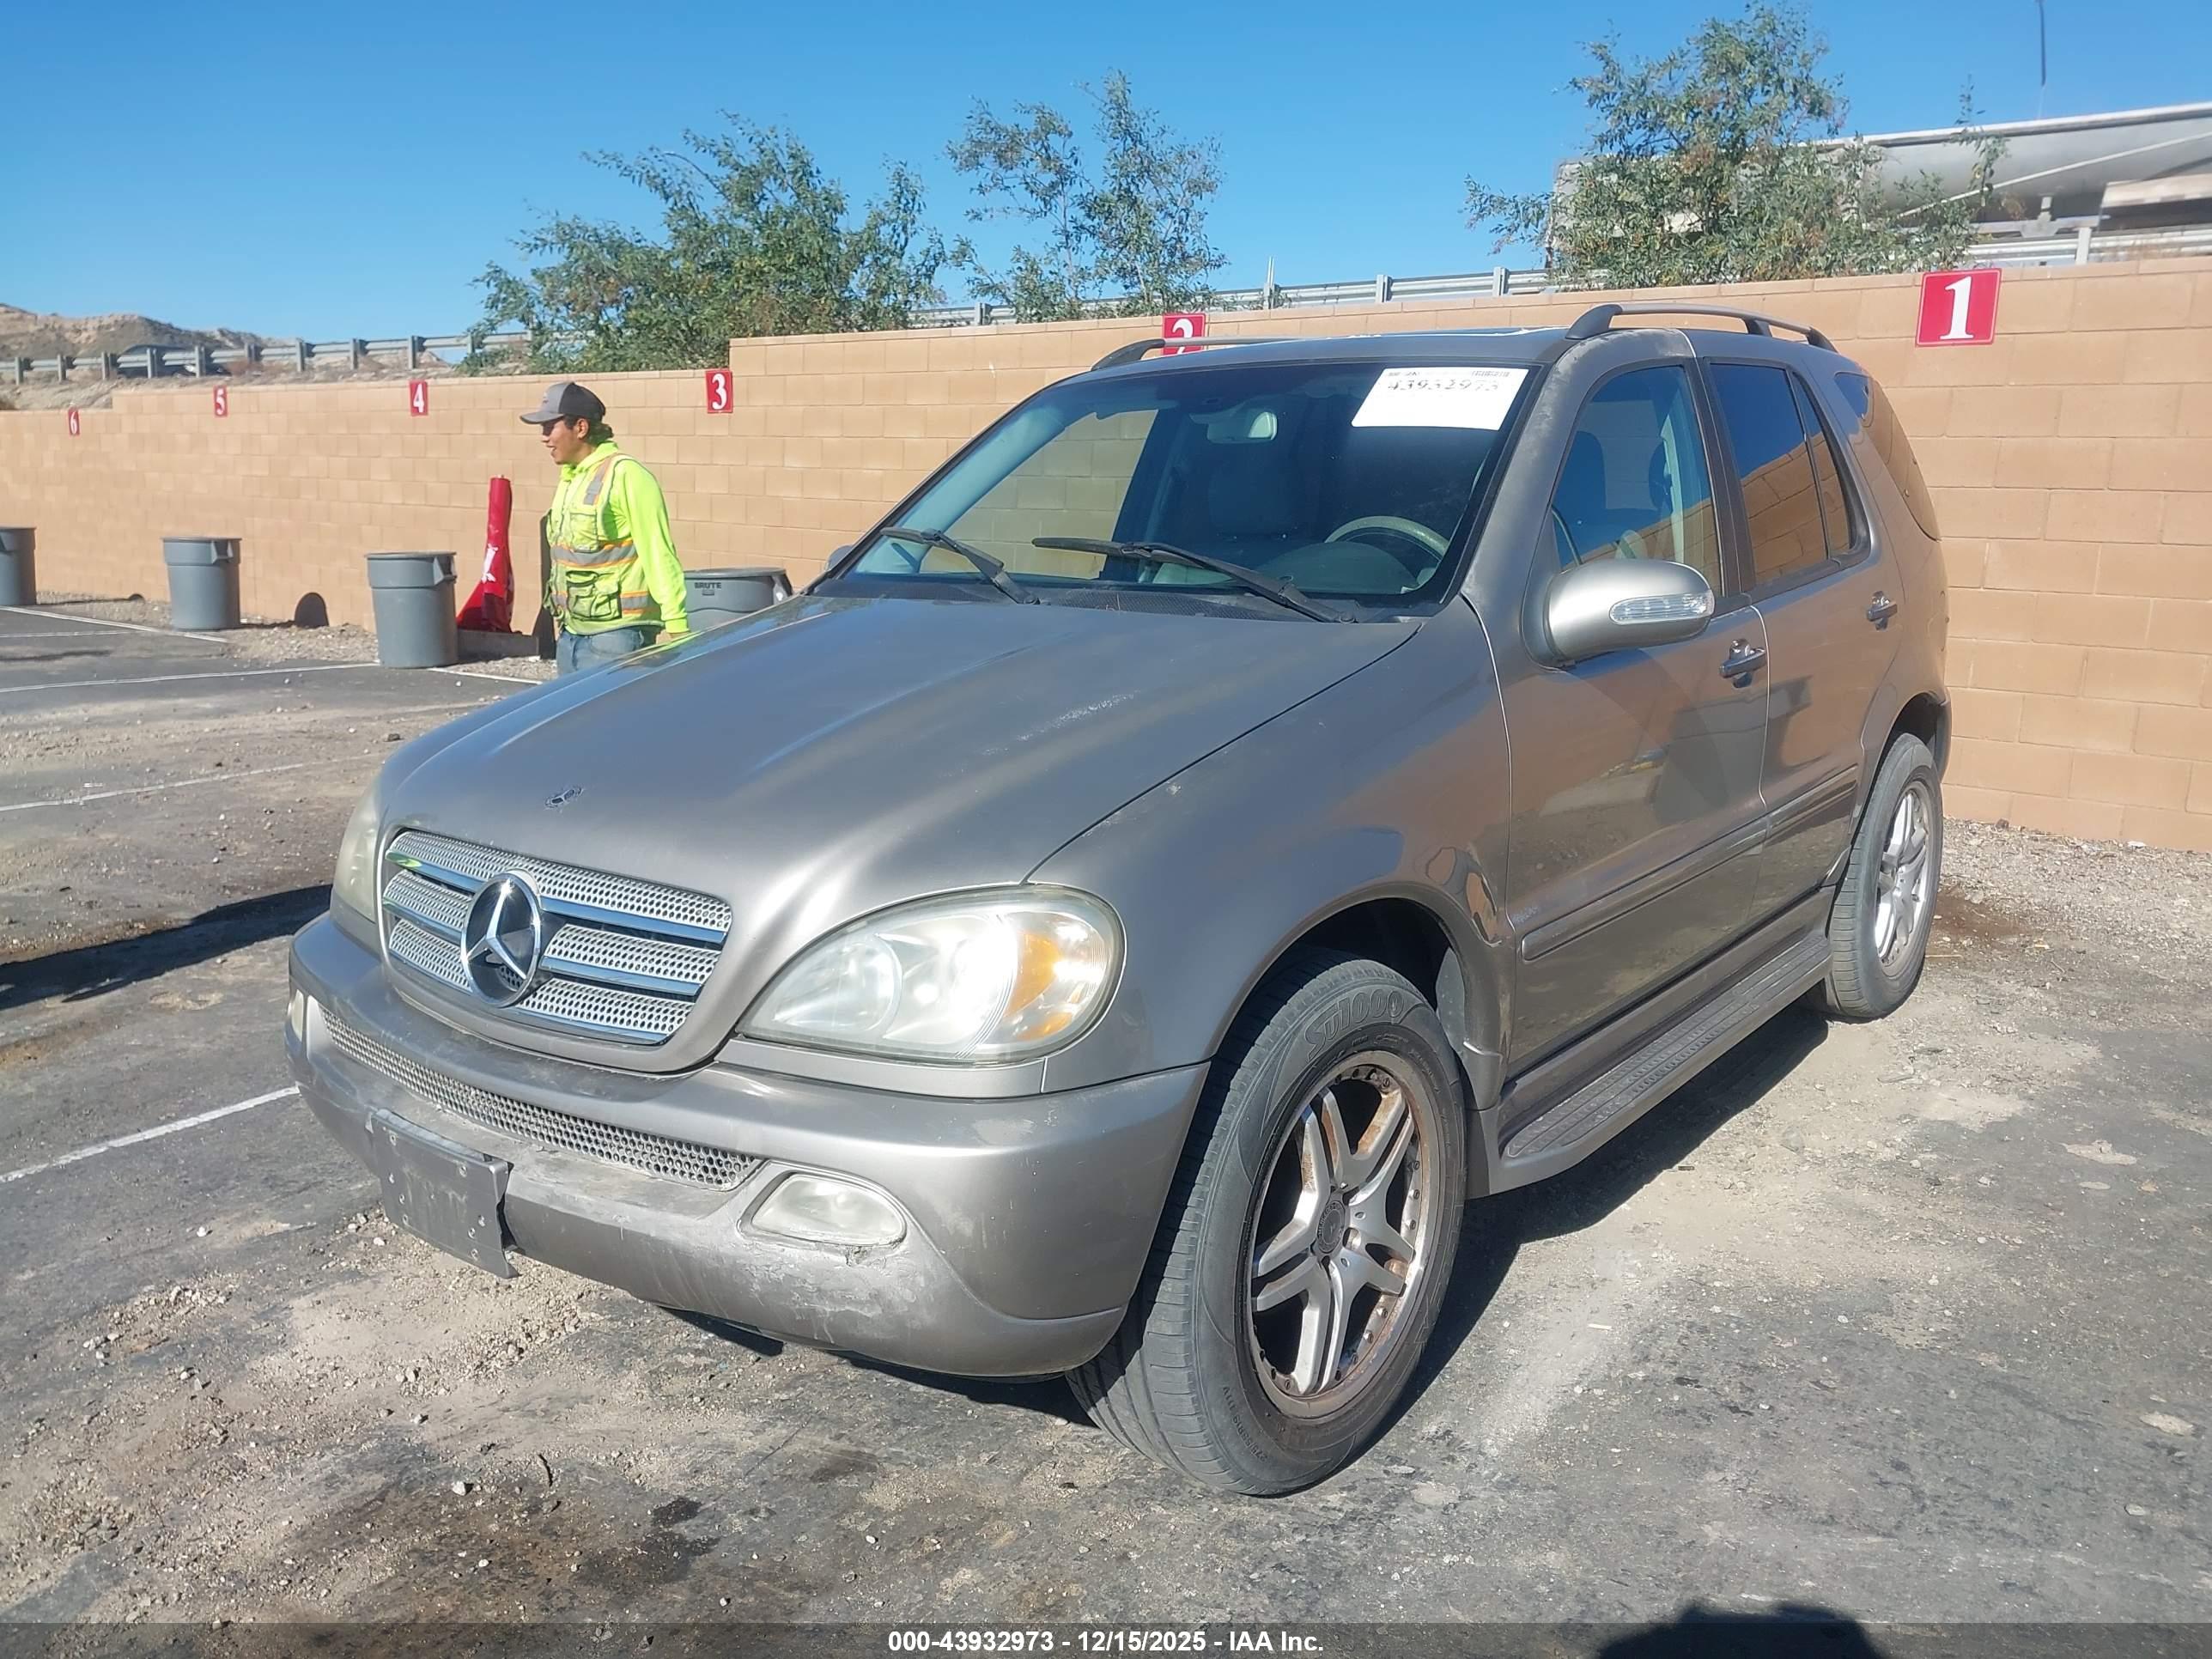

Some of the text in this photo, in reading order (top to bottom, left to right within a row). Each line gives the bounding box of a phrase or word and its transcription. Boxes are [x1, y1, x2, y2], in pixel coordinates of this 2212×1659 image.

[1940, 276, 1974, 340] 1
[216, 390, 225, 415] 5
[413, 386, 425, 412] 4
[712, 373, 727, 410] 3
[70, 411, 78, 434] 6
